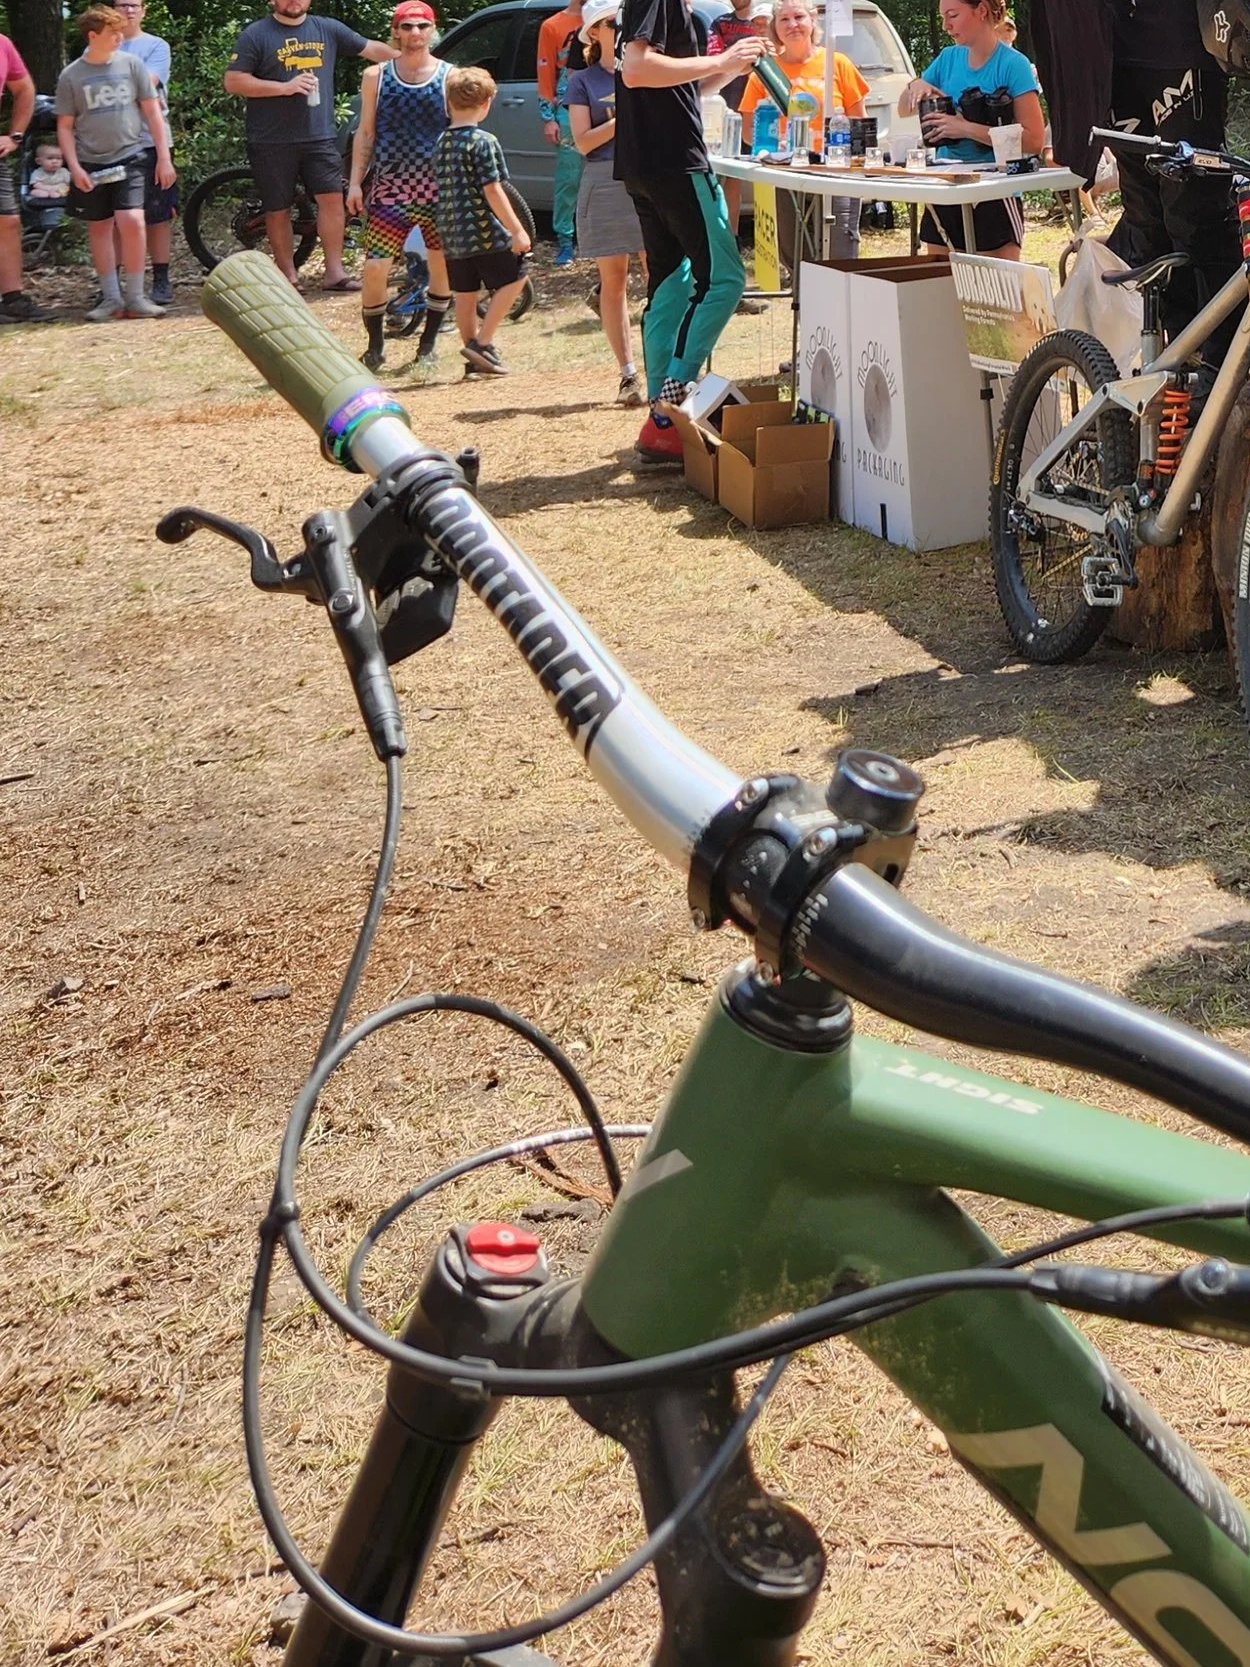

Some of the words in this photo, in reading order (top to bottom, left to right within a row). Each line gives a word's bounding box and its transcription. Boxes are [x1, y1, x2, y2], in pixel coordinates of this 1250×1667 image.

[83, 84, 130, 109] Lee
[857, 448, 904, 486] PACKAGING
[1239, 545, 1250, 599] MINION
[883, 1057, 1045, 1115] SIGHT
